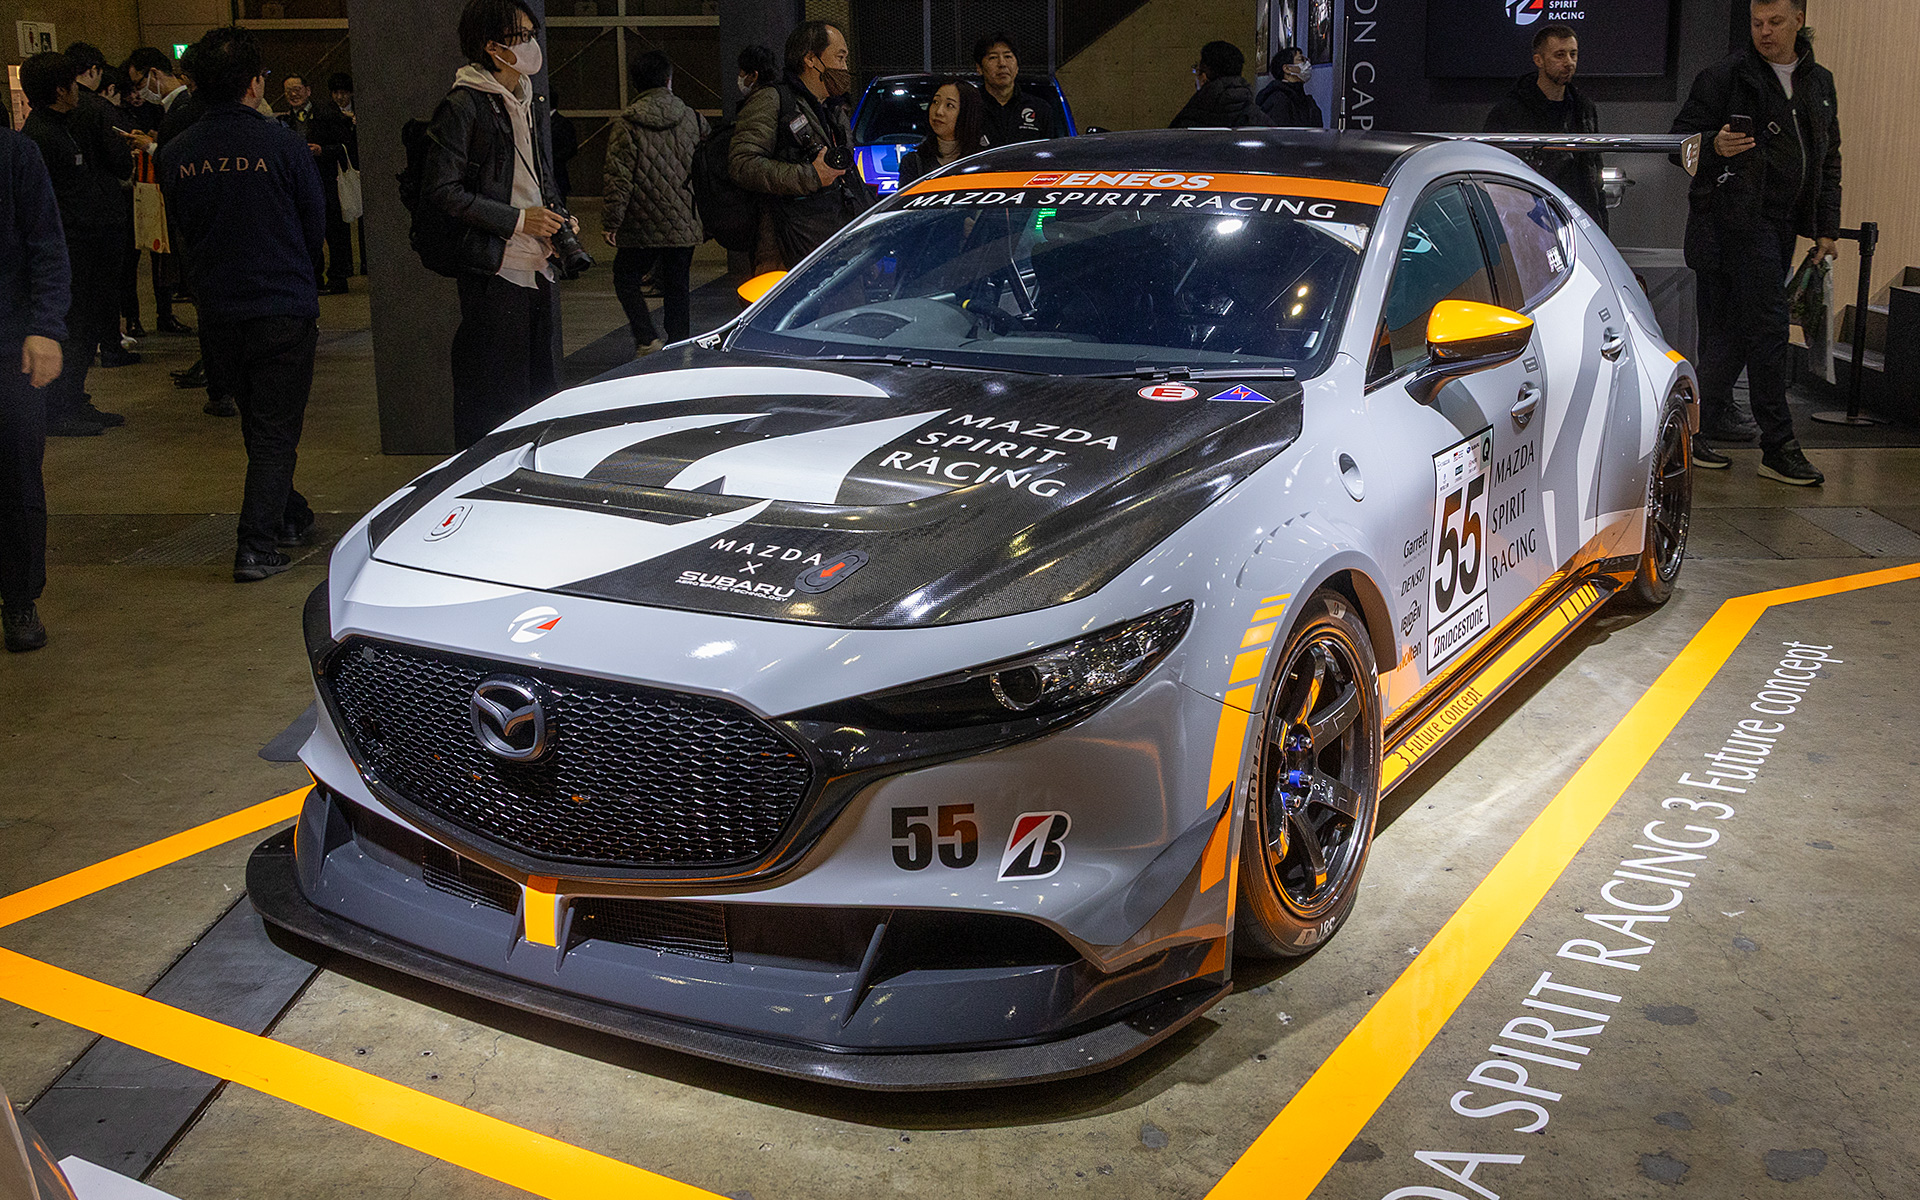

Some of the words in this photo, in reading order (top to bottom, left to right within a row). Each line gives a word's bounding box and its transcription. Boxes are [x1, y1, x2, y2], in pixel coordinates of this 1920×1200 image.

[1548, 0, 1578, 9] SPIRIT
[1548, 11, 1585, 20] RACING
[180, 157, 268, 179] MAZDA
[1060, 172, 1215, 190] ENEOS
[902, 191, 1026, 209] MAZDA
[1037, 191, 1162, 207] SPIRIT
[1170, 193, 1337, 219] RACING
[916, 431, 1067, 464] SPIRIT
[948, 413, 1119, 450] MAZDA
[1482, 436, 1491, 463] Q
[879, 450, 1067, 498] RACING
[1494, 440, 1535, 488] MAZDA
[1492, 488, 1527, 535] SPIRIT
[709, 538, 823, 566] MAZDA
[1403, 528, 1429, 559] Garrett
[1435, 473, 1486, 614] 55
[1492, 528, 1537, 582] RACING
[679, 570, 797, 599] SUBARU
[1400, 566, 1426, 597] DENSO
[1432, 605, 1484, 660] BRIDGESTONE
[1750, 640, 1844, 715] concept
[1394, 750, 1411, 768] 3
[1404, 720, 1444, 759] Future
[1439, 686, 1483, 725] concept
[1677, 719, 1785, 794] Future
[1661, 797, 1735, 820] 3
[891, 803, 979, 872] 55
[1556, 820, 1721, 972] RACING
[1450, 971, 1623, 1133] SPIRIT
